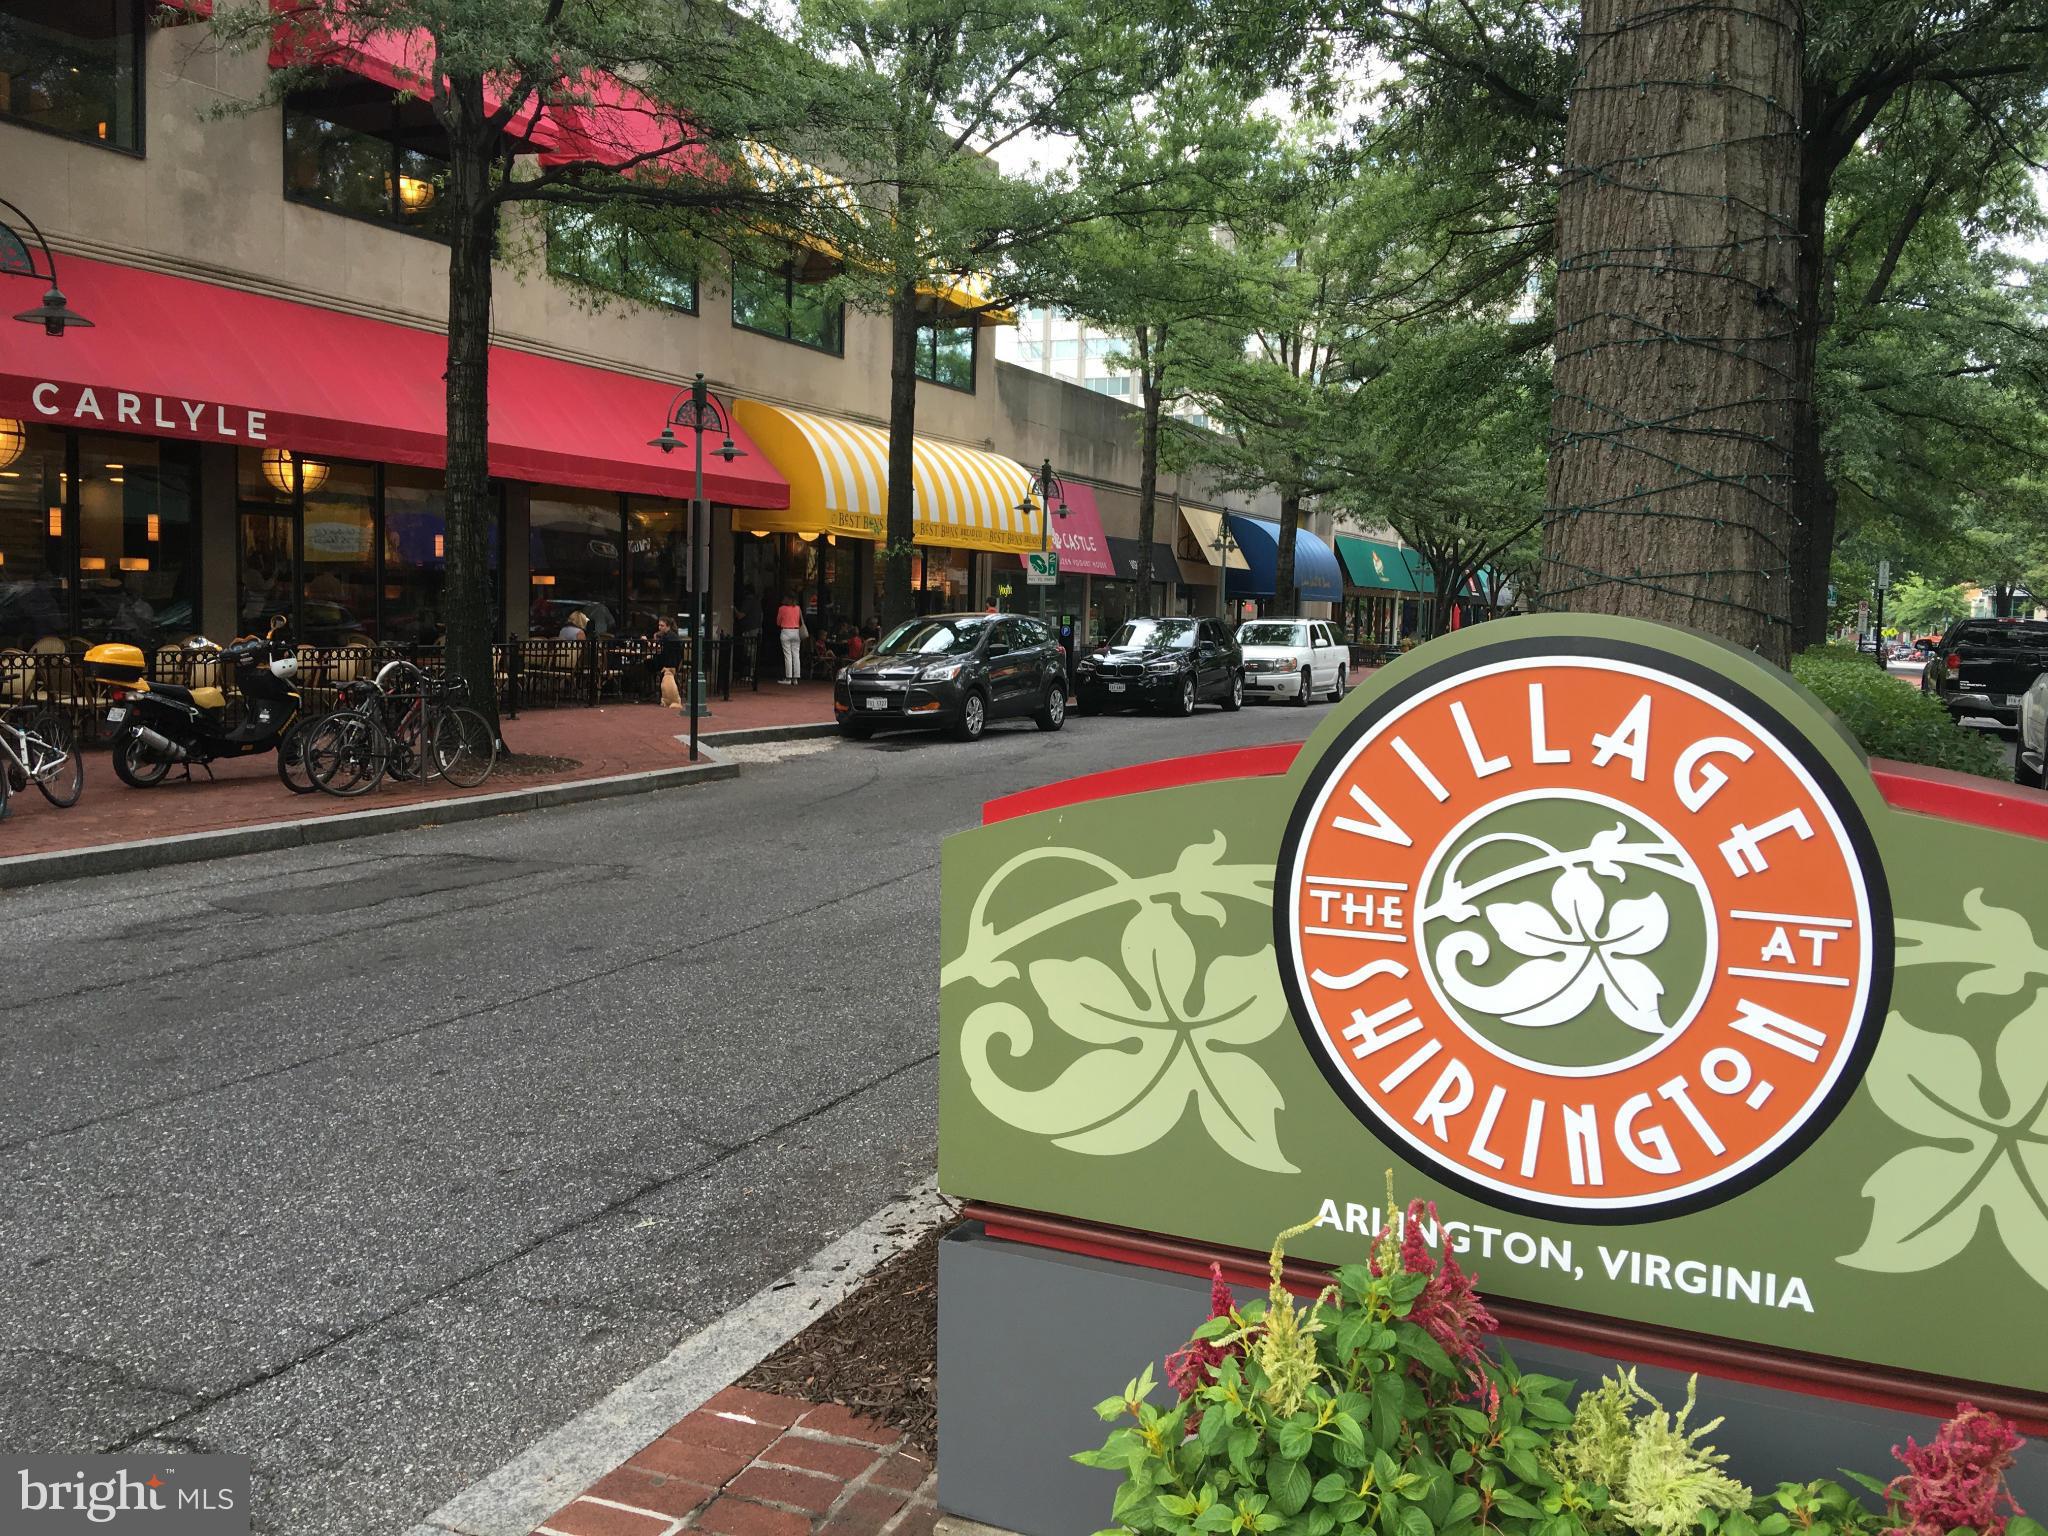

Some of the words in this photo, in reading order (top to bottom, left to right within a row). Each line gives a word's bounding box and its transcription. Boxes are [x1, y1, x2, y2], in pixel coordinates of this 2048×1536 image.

[32, 382, 267, 441] CARLYLE
[1049, 553, 1056, 563] 2
[1062, 532, 1097, 552] CASTLE
[1331, 683, 1814, 878] VILLAGE
[1308, 888, 1404, 930] THE
[1760, 928, 1839, 967] AT
[1310, 958, 1827, 1185] SHIRLINGTON
[1598, 1245, 1814, 1313] VIRGINIA
